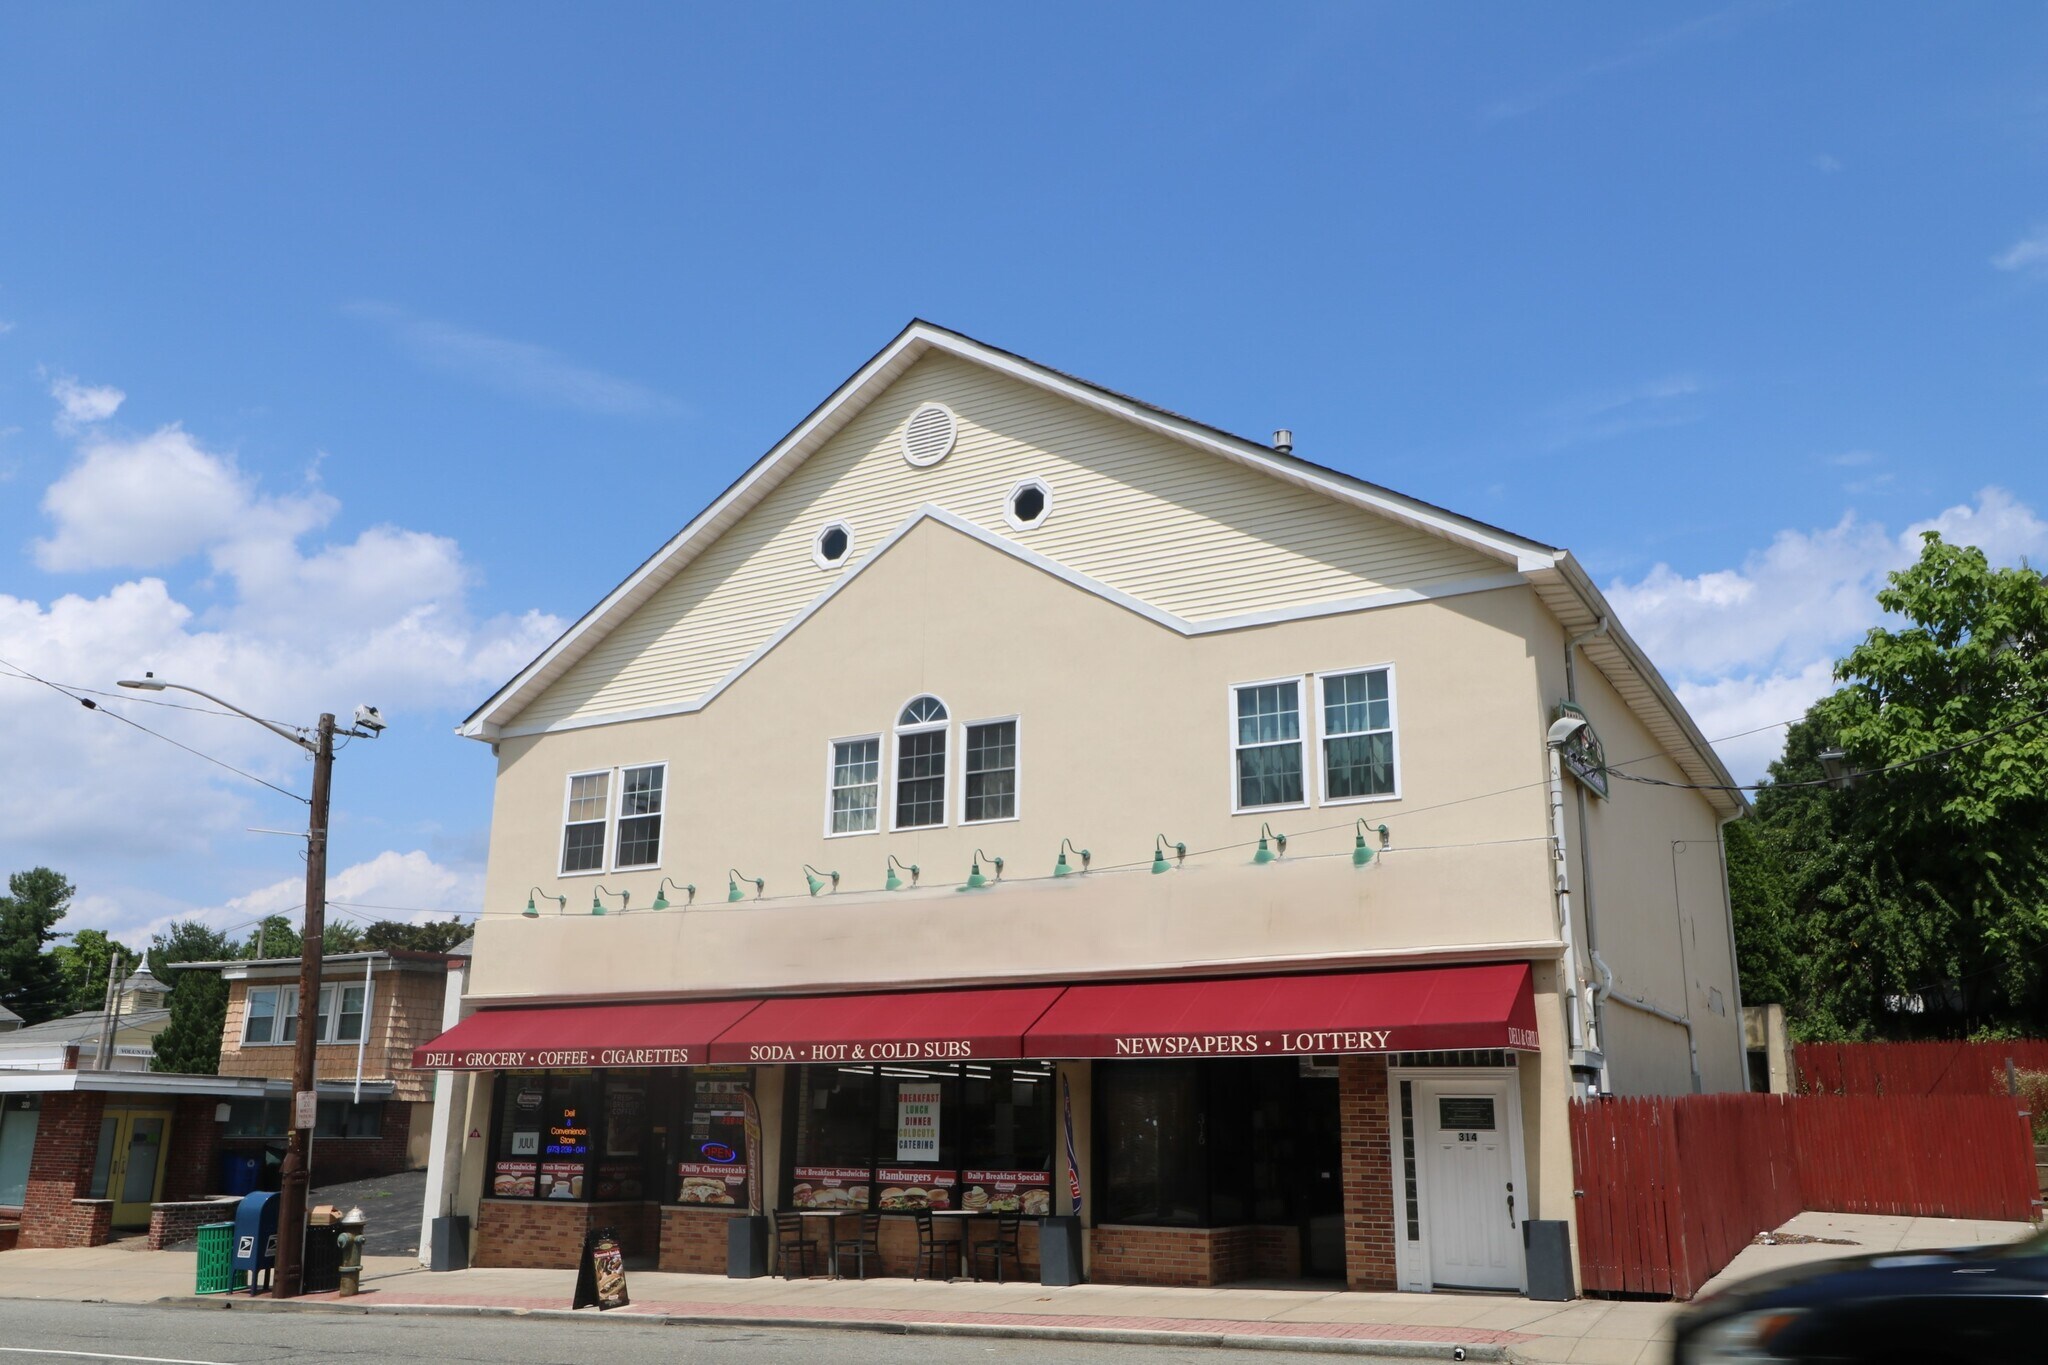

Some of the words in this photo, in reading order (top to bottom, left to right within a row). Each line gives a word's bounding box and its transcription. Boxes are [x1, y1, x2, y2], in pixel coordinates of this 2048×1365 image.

[1508, 1027, 1521, 1045] DELI
[1115, 1035, 1257, 1055] NEWSPAPERS
[1282, 1031, 1391, 1051] LOTTERY
[750, 1045, 795, 1060] SODA
[812, 1044, 848, 1060] HOT
[851, 1044, 865, 1059] &
[870, 1043, 920, 1059] COLD
[924, 1040, 971, 1057] SUBS
[425, 1053, 454, 1066] DELI
[465, 1052, 526, 1066] GROCERY
[538, 1051, 588, 1065] COFFEE
[601, 1049, 688, 1064] CIGARETTES
[898, 1093, 940, 1103] BREAKFAST
[564, 1109, 576, 1117] Deli
[905, 1105, 929, 1114] LUNCH
[905, 1117, 932, 1126] DINNER
[551, 1127, 586, 1136] Convenience
[559, 1136, 576, 1145] Store
[1458, 1132, 1478, 1142] 314
[518, 1138, 534, 1149] JUUL
[899, 1140, 934, 1150] CATERING
[704, 1147, 732, 1158] OPEN
[681, 1164, 701, 1174] Philly
[702, 1166, 746, 1175] Cheesesteaks
[795, 1168, 807, 1176] Hot
[808, 1168, 835, 1177] Breakfast
[836, 1169, 870, 1178] Sandwiches
[879, 1170, 931, 1183] Hamburgers
[967, 1172, 984, 1181] Daily
[986, 1172, 1016, 1180] Breakfast
[1017, 1173, 1045, 1182] Specials
